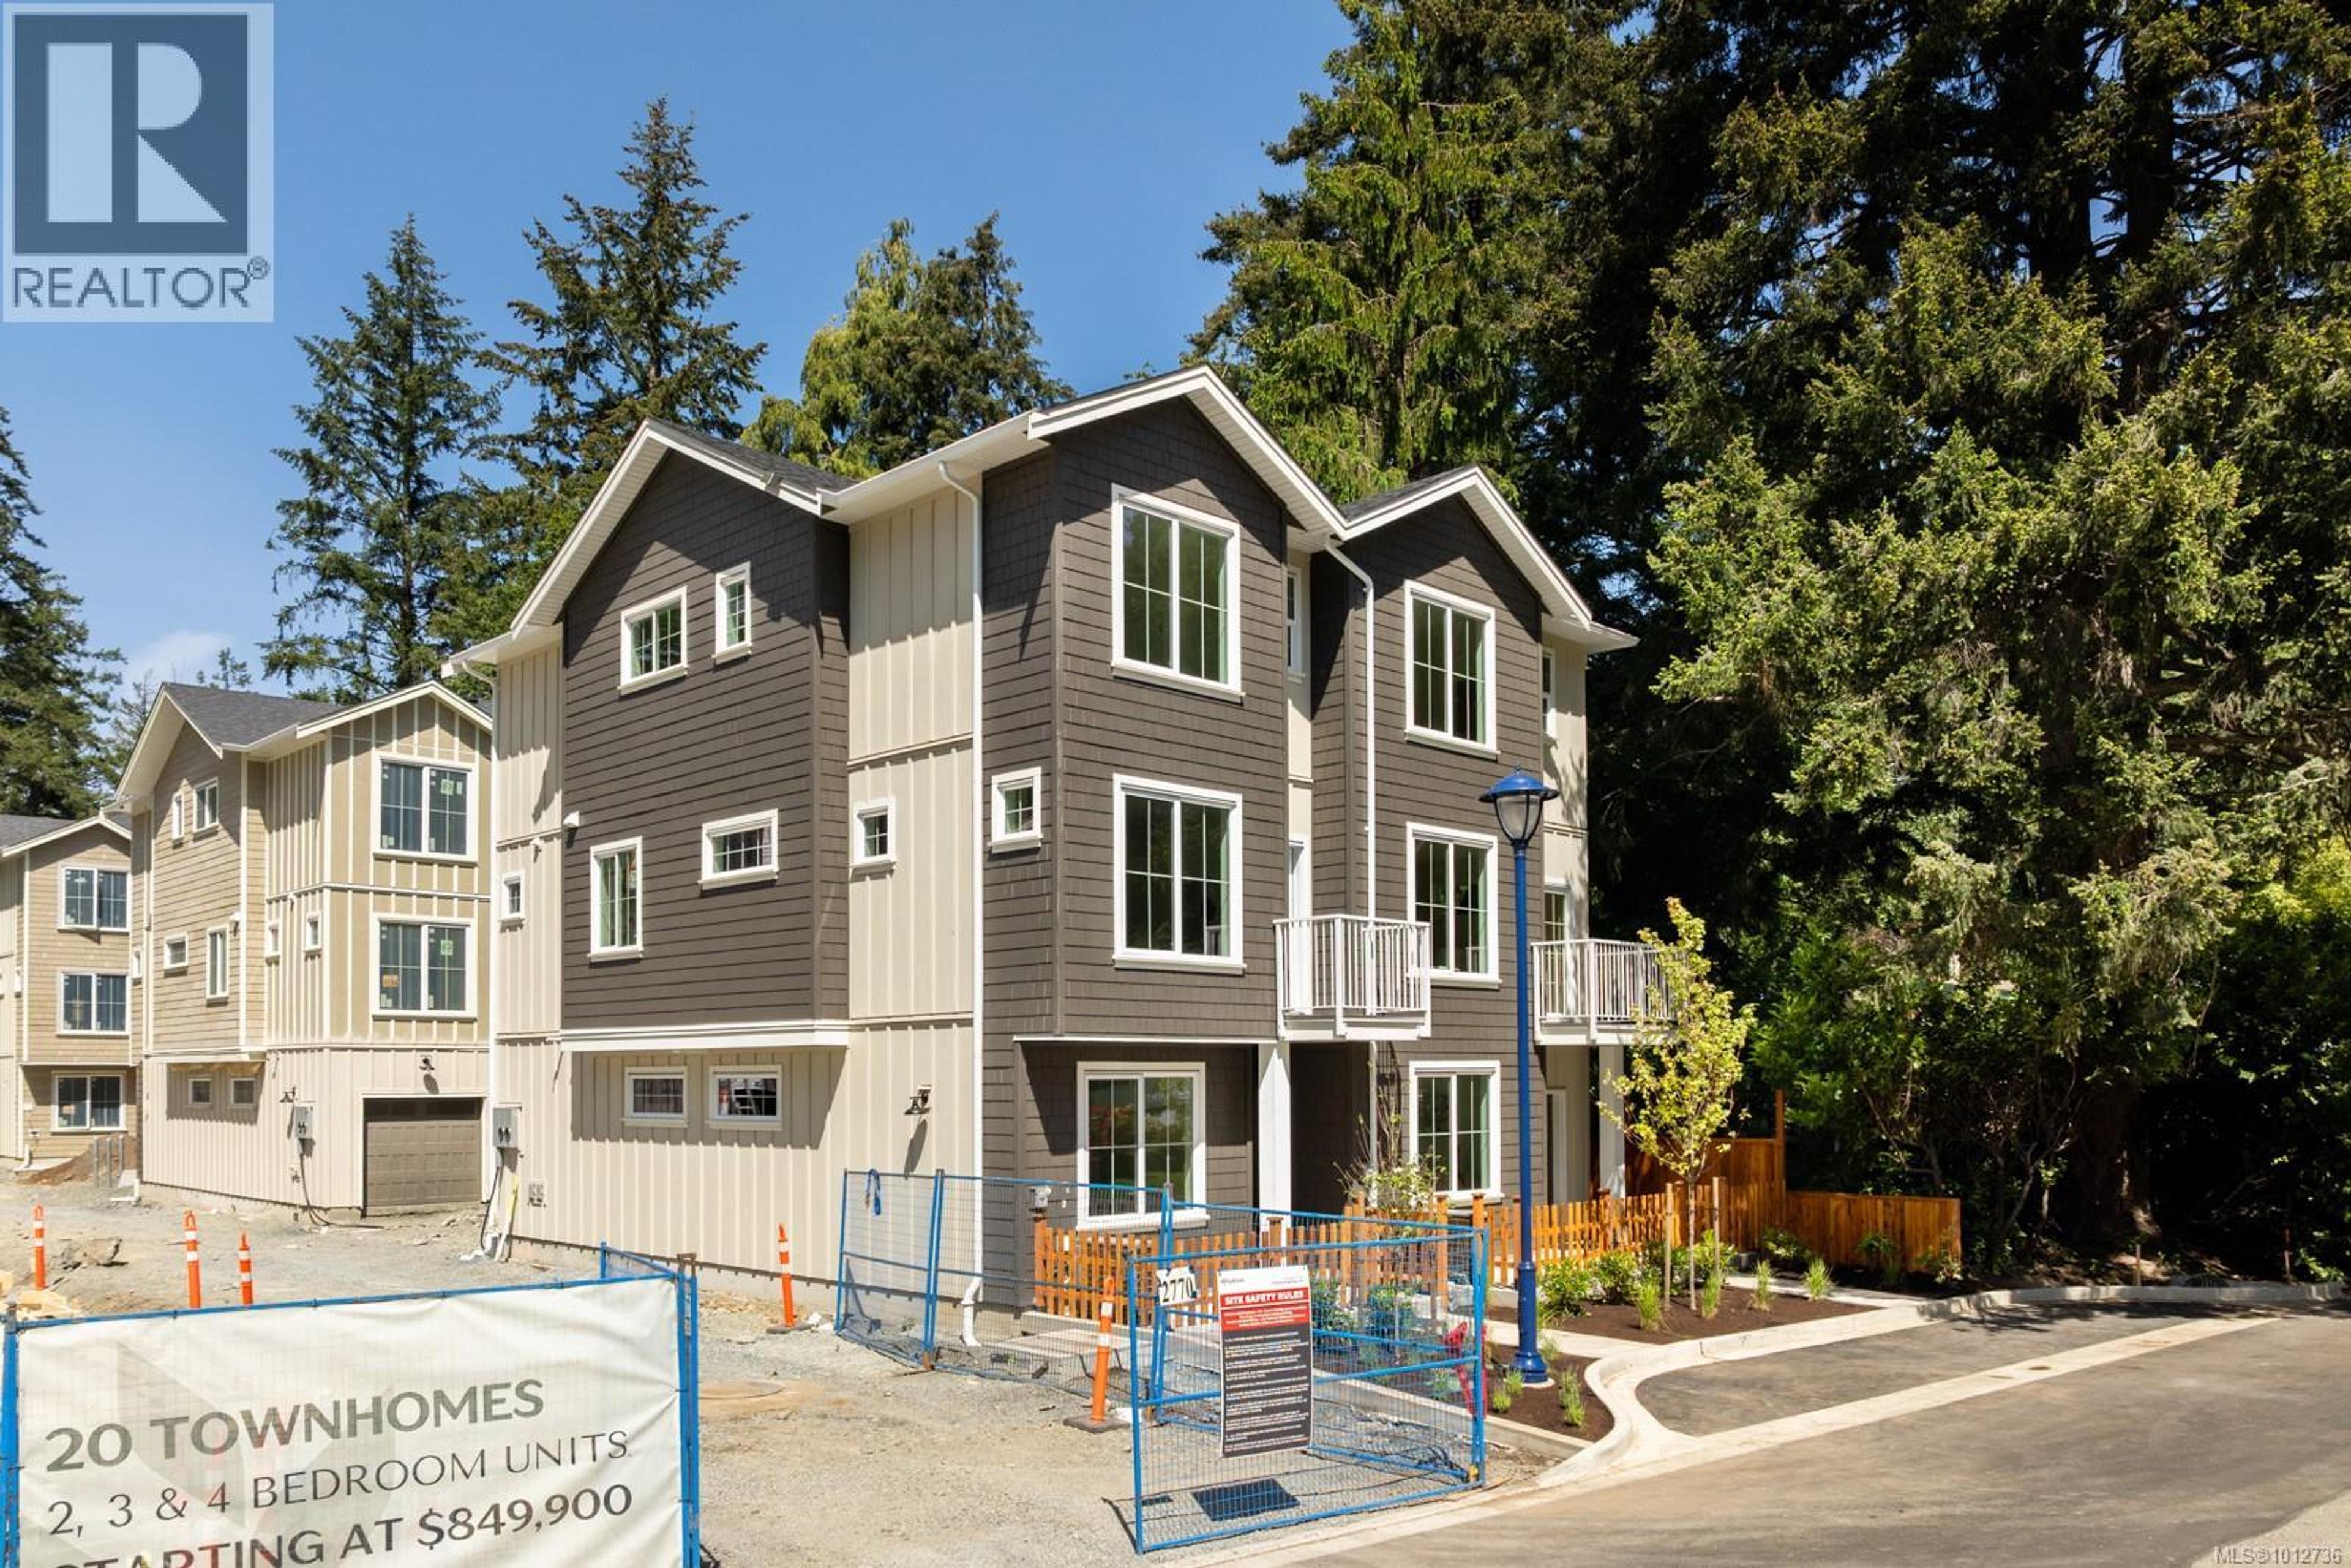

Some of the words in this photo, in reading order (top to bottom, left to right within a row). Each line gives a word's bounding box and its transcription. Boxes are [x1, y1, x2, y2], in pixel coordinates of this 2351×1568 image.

[1162, 1277, 1194, 1303] 2770
[1225, 1295, 1244, 1306] SITE
[1245, 1291, 1277, 1304] SAFETY
[1278, 1290, 1304, 1300] RULES
[45, 1422, 133, 1472] 20
[149, 1378, 544, 1460] TOWNHOMES
[48, 1500, 83, 1538] 2,
[108, 1493, 133, 1528] 3
[155, 1487, 188, 1520] &
[206, 1481, 230, 1513] 4
[252, 1448, 486, 1509] BEDROOM
[505, 1430, 628, 1474] UNITS
[54, 1530, 324, 1568] RTING
[339, 1517, 403, 1559] AT
[417, 1483, 632, 1550] $849,900
